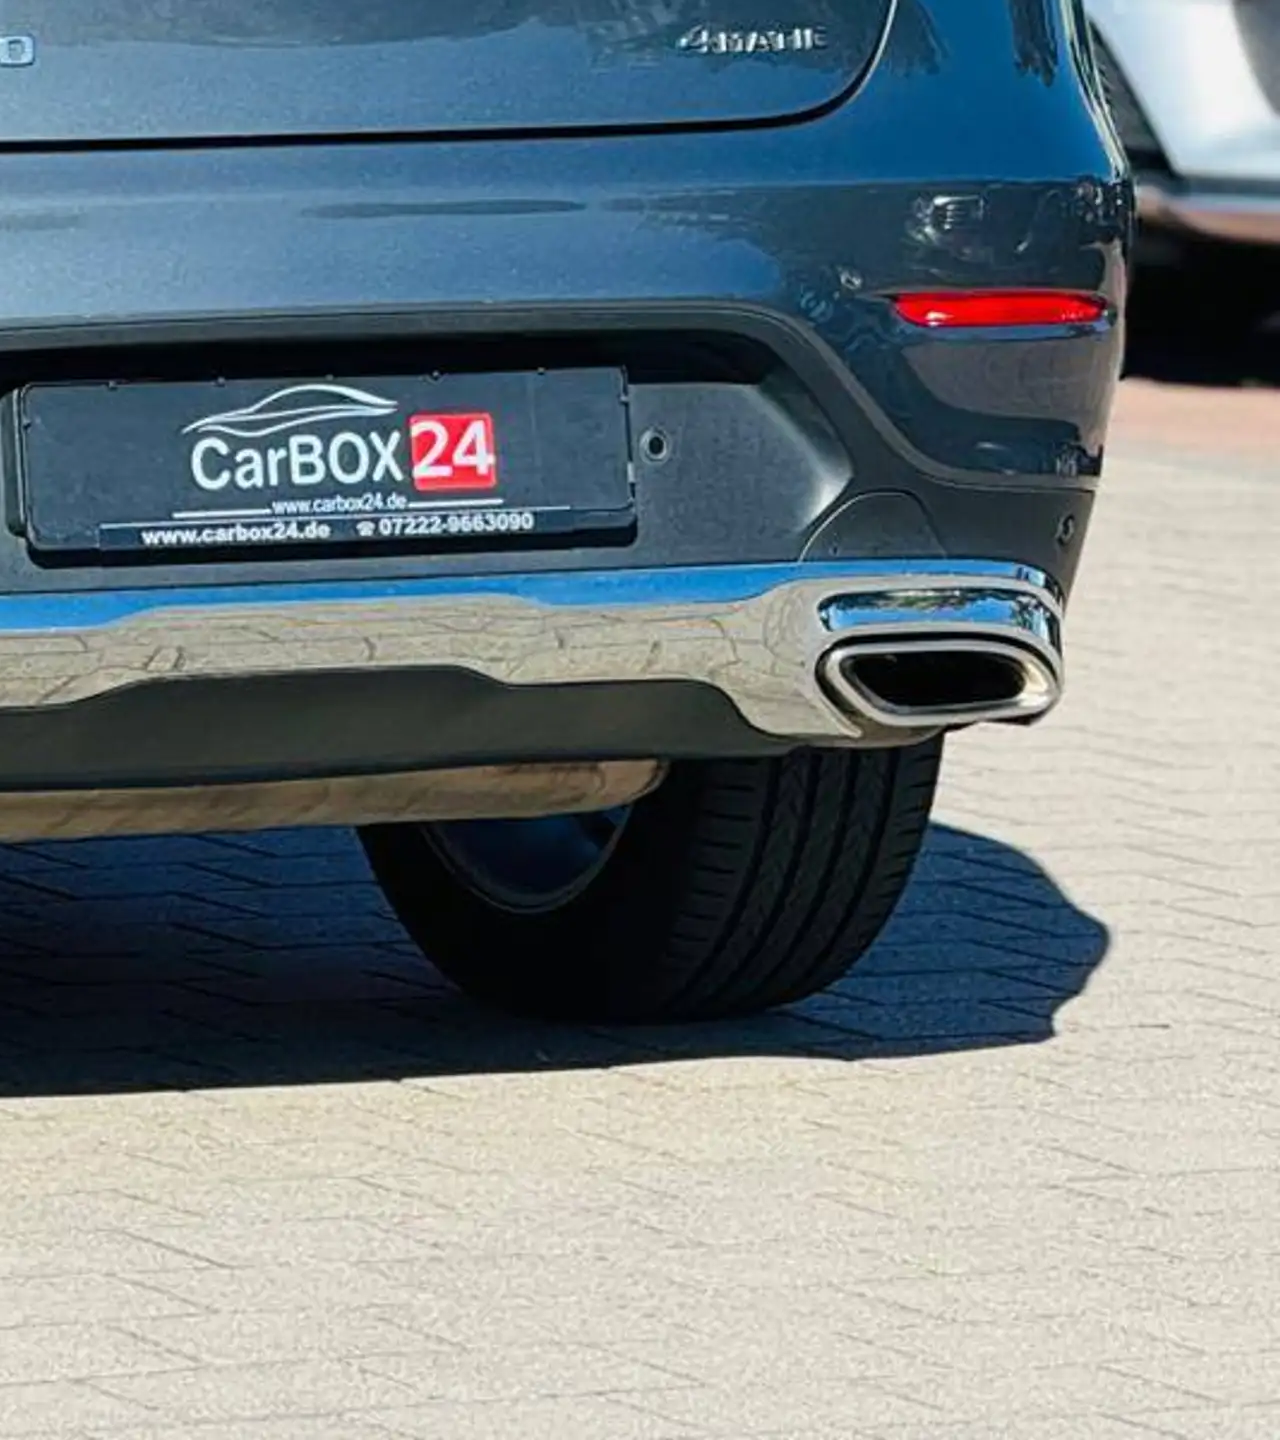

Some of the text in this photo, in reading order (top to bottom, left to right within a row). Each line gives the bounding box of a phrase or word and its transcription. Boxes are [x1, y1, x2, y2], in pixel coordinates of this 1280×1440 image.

[272, 493, 408, 515] www.carbox24.de
[140, 512, 535, 546] www.carbox24.de 07222-9663090
